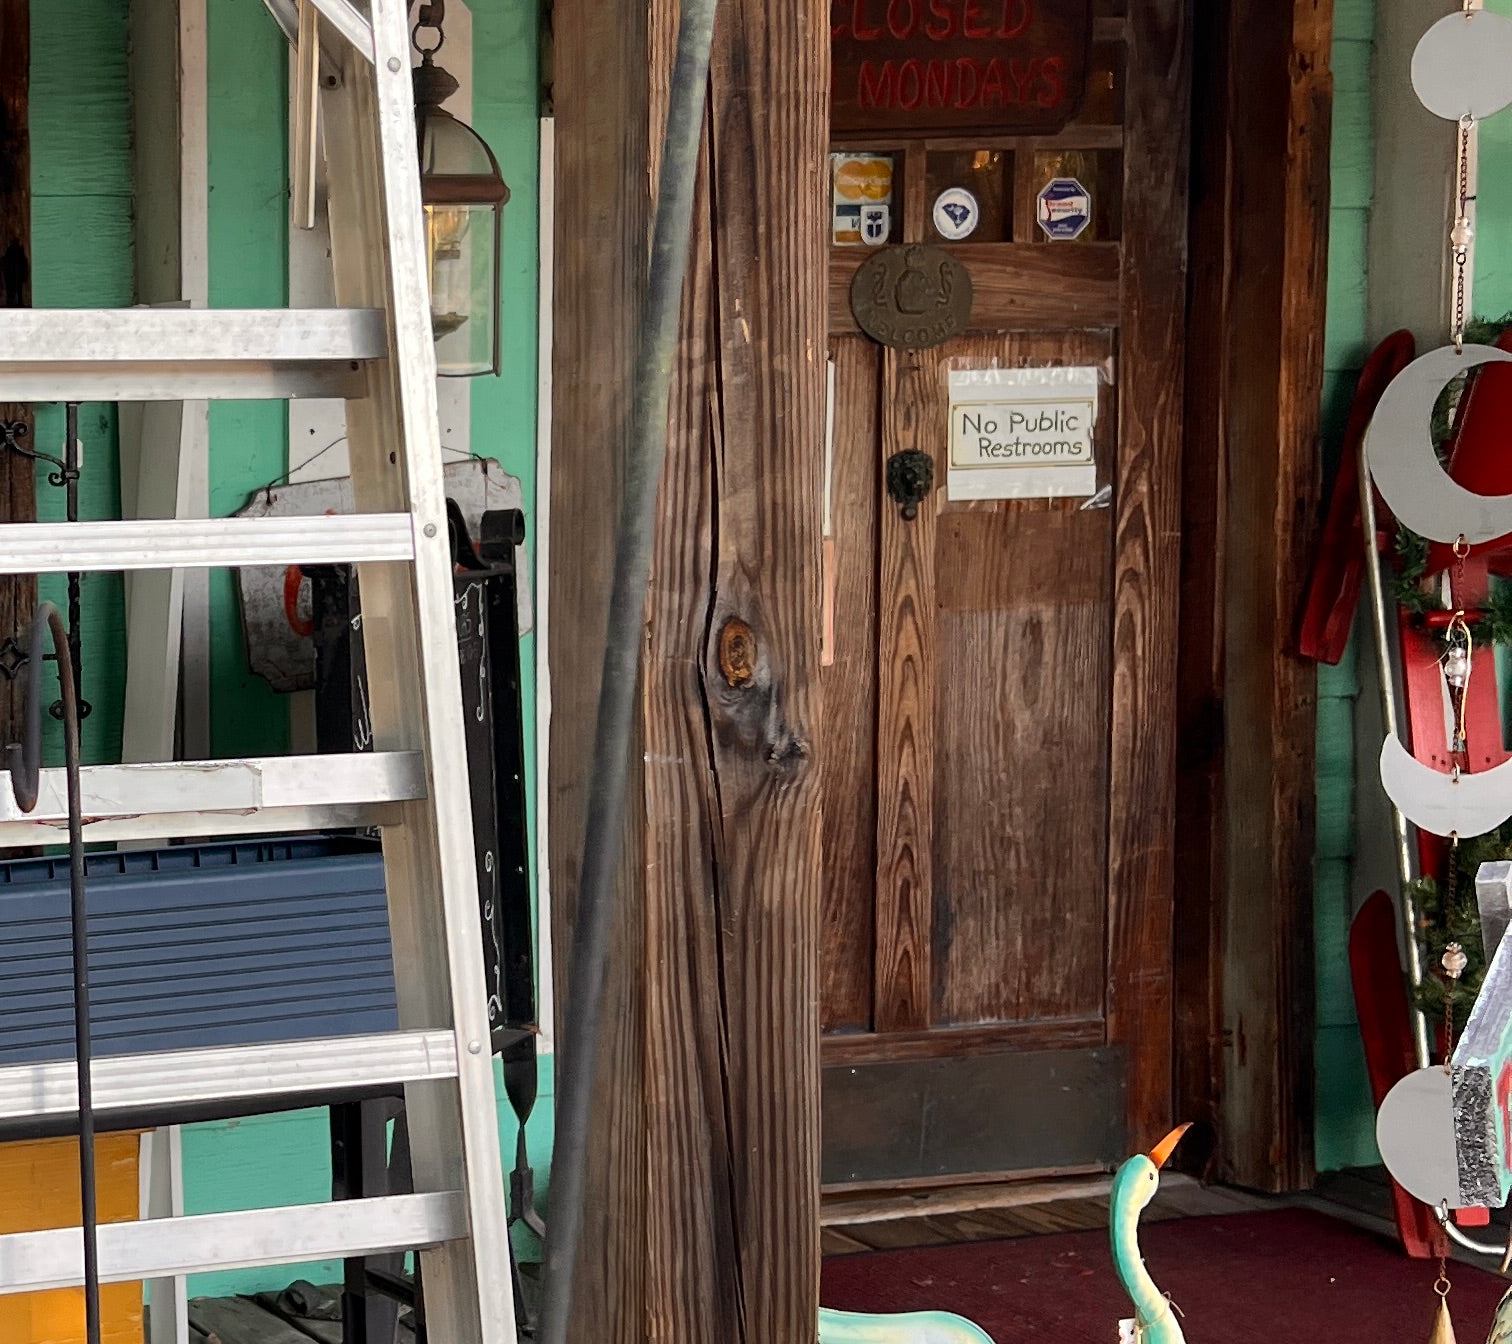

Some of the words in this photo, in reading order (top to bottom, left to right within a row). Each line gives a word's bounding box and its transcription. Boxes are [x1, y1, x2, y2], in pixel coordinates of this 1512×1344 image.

[858, 56, 1066, 111] MONDAYS
[867, 310, 957, 344] WELCOME
[962, 413, 998, 435] No
[1009, 410, 1079, 434] Public
[978, 436, 1083, 458] Restrooms
